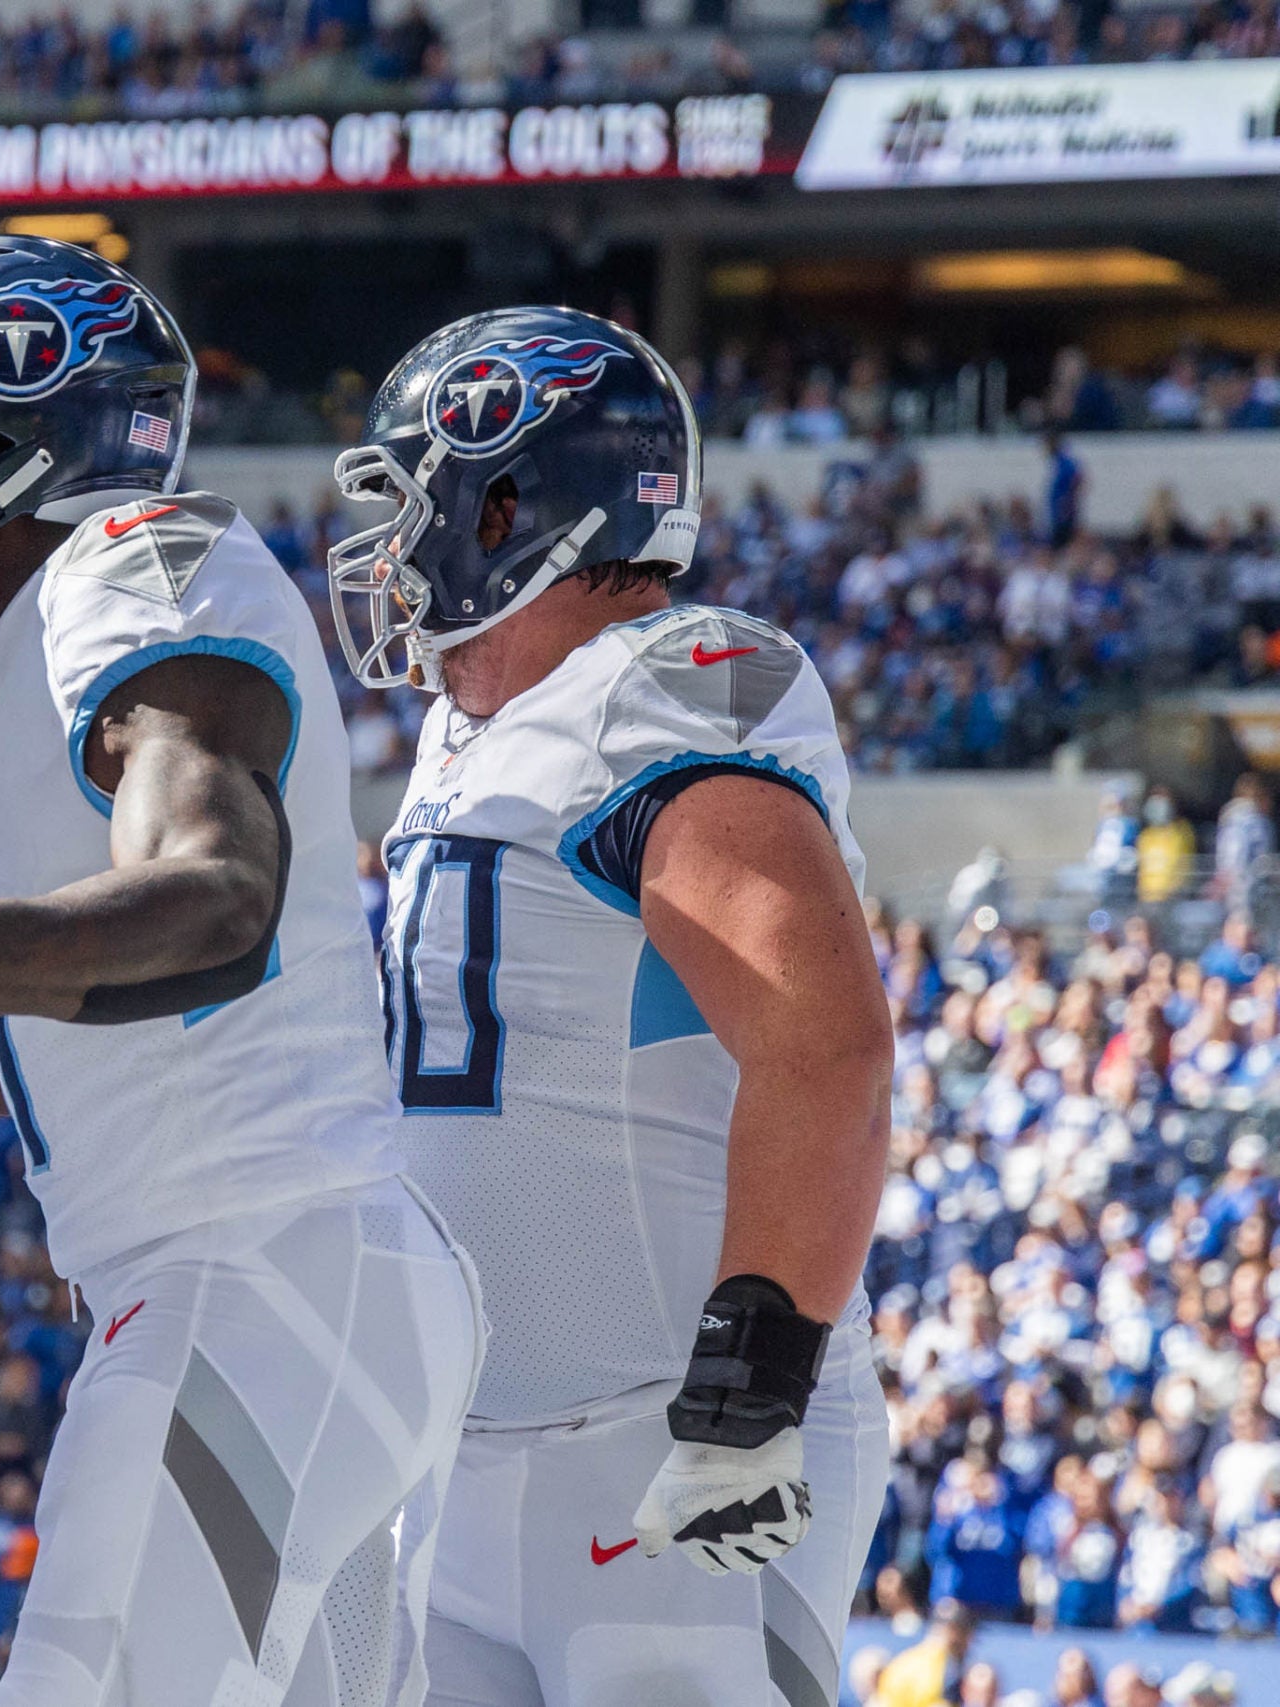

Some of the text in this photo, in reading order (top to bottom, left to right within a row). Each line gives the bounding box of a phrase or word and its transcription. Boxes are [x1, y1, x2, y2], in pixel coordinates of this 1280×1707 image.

[38, 113, 328, 196] PHYSICIANS
[331, 111, 401, 184] OF
[403, 107, 508, 182] THE
[509, 102, 669, 178] COLTS
